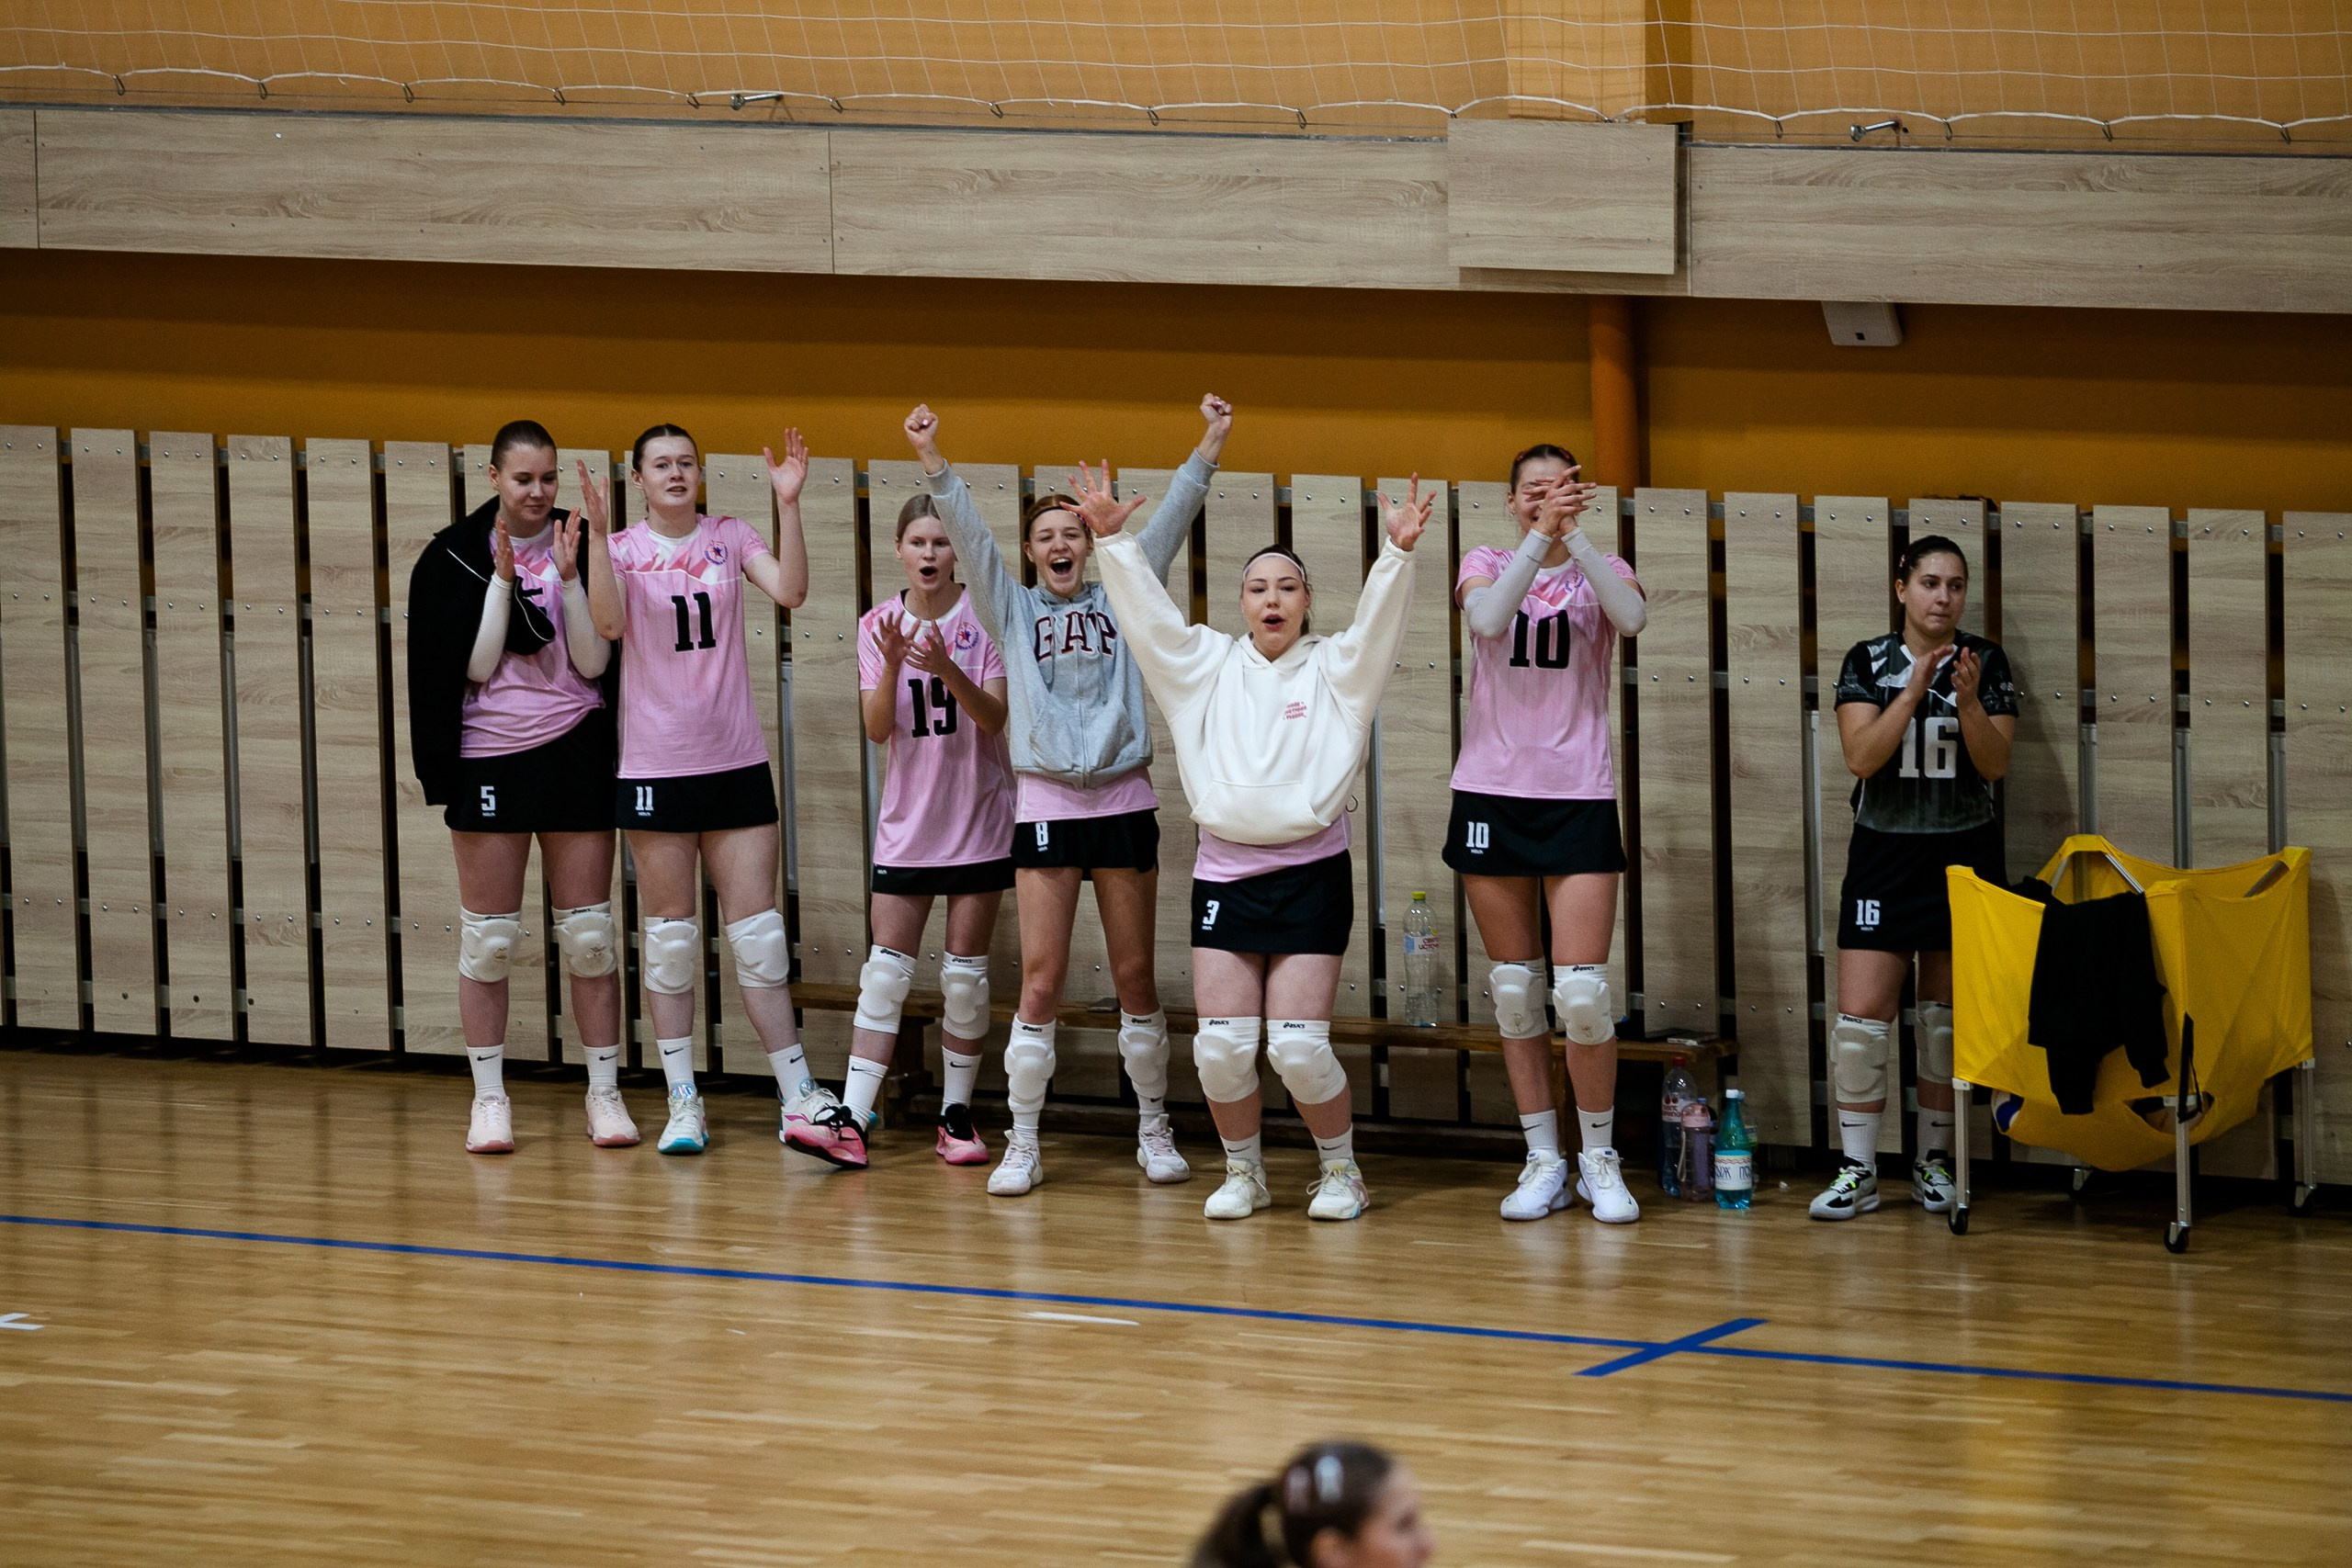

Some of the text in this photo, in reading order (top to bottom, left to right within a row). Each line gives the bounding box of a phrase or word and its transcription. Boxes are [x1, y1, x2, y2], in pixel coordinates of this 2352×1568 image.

[669, 591, 717, 653] 11
[1034, 611, 1118, 662] GAP
[1509, 609, 1570, 670] 10
[908, 676, 957, 739] 19
[1898, 716, 1959, 779] 16
[481, 785, 496, 811] 5
[635, 785, 654, 811] 11
[1035, 821, 1048, 846] 8
[1465, 821, 1489, 849] 10
[1203, 899, 1220, 925] 3
[1856, 899, 1880, 925] 16
